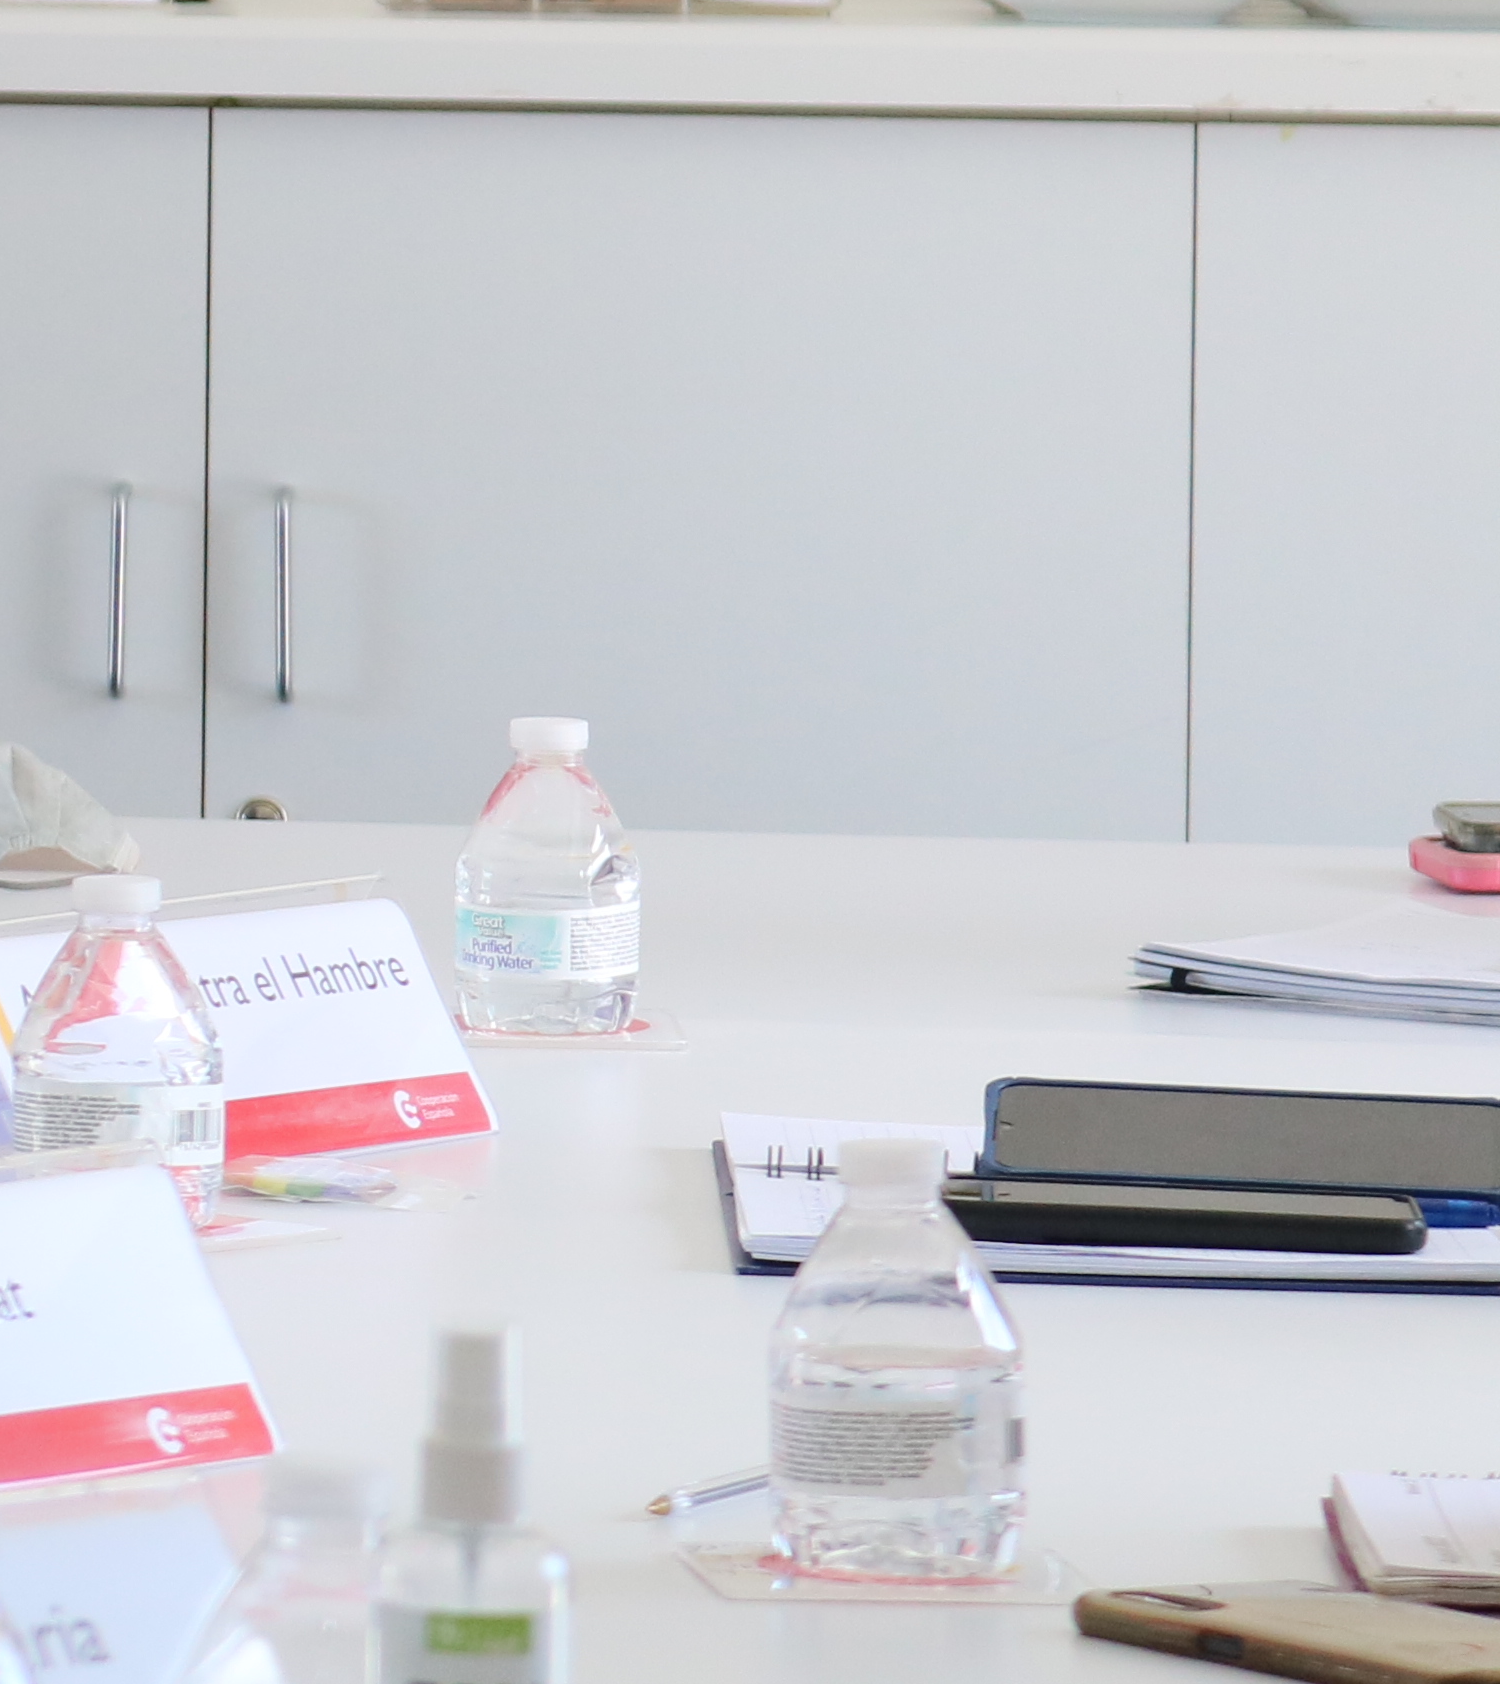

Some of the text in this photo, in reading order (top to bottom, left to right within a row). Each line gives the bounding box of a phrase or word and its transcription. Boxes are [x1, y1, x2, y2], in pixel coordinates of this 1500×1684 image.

[471, 937, 513, 955] Purified
[496, 955, 535, 970] Water
[254, 956, 285, 1001] el
[280, 947, 411, 1000] Hambre
